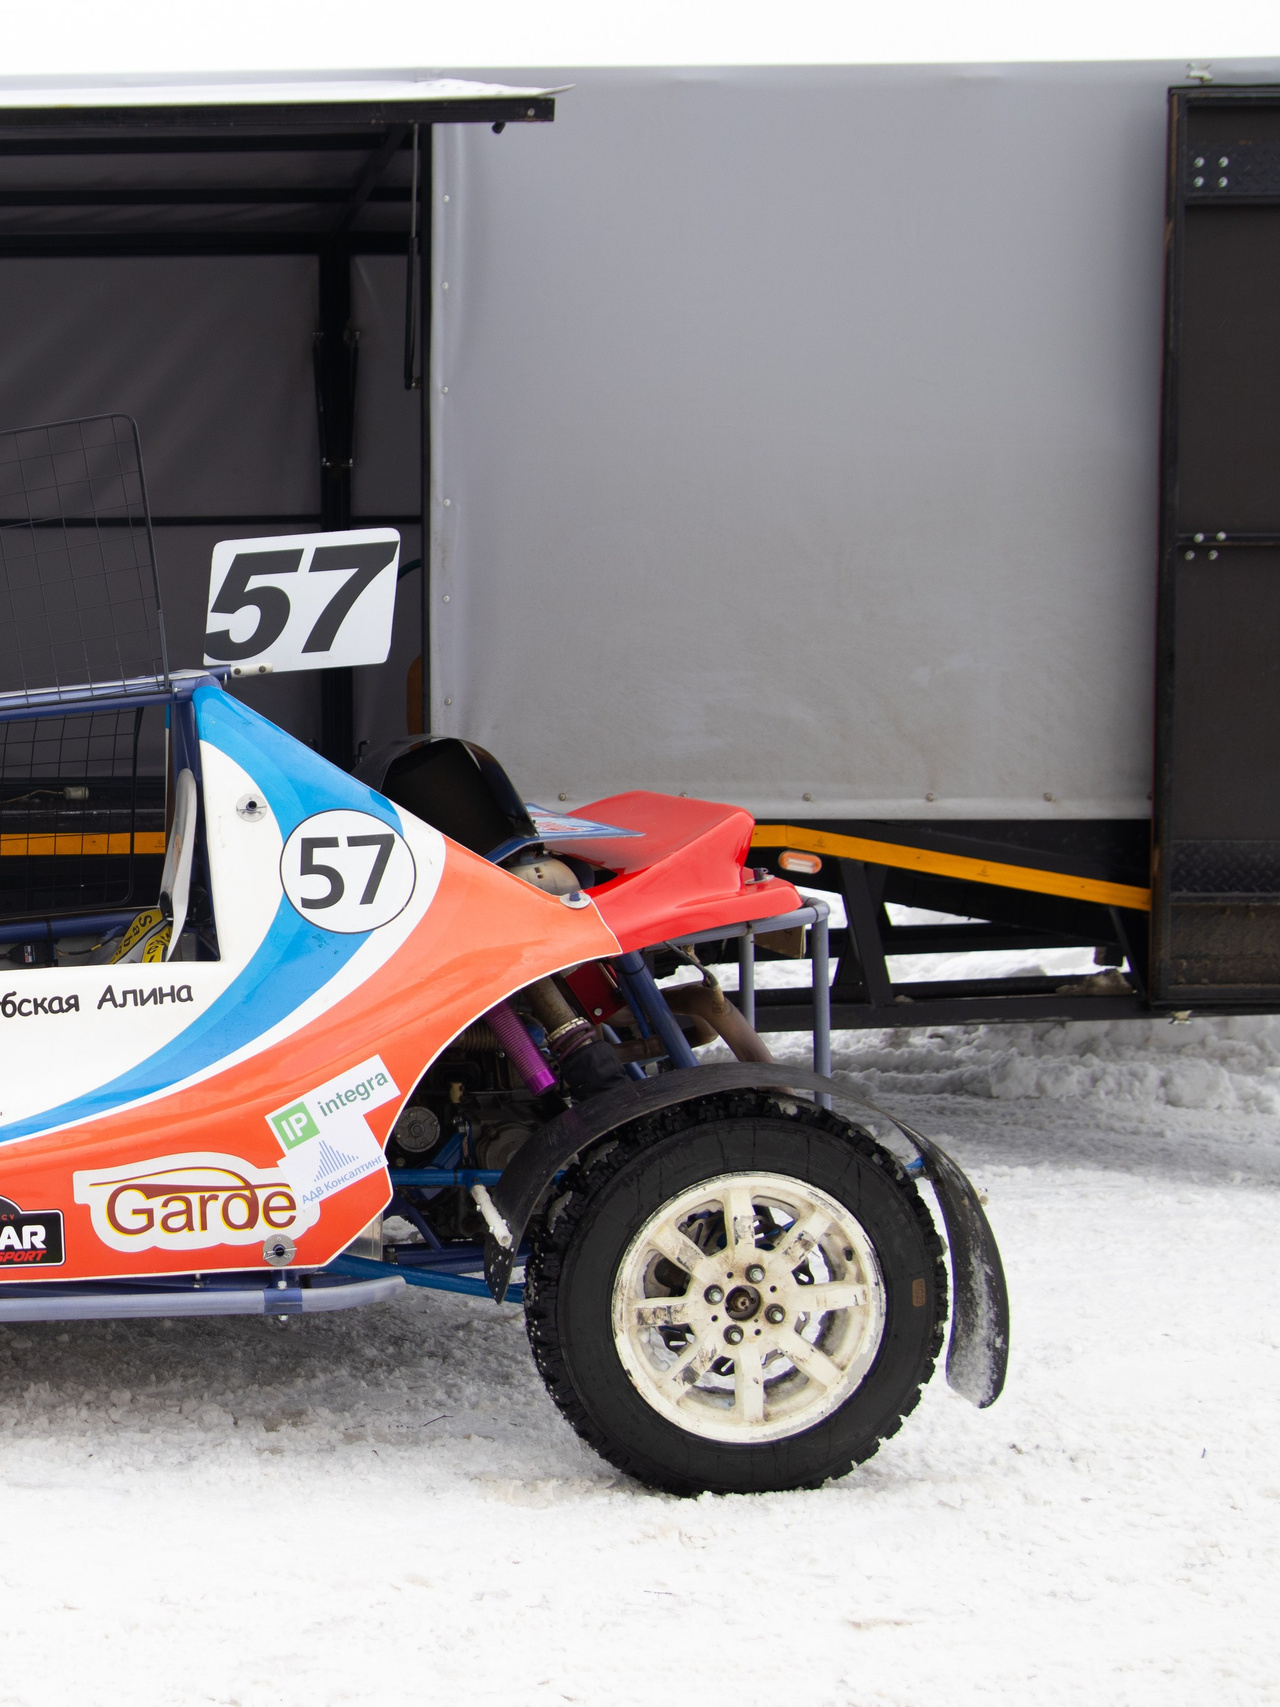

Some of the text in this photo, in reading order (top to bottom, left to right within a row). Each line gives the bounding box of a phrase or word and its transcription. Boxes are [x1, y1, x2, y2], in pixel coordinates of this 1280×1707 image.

[205, 541, 399, 661] 57
[300, 833, 395, 910] 57
[97, 984, 194, 1010] Алина
[280, 1072, 389, 1142] IP integra
[104, 1167, 298, 1237] Garde
[301, 1156, 383, 1205] АДВ Консалтинг
